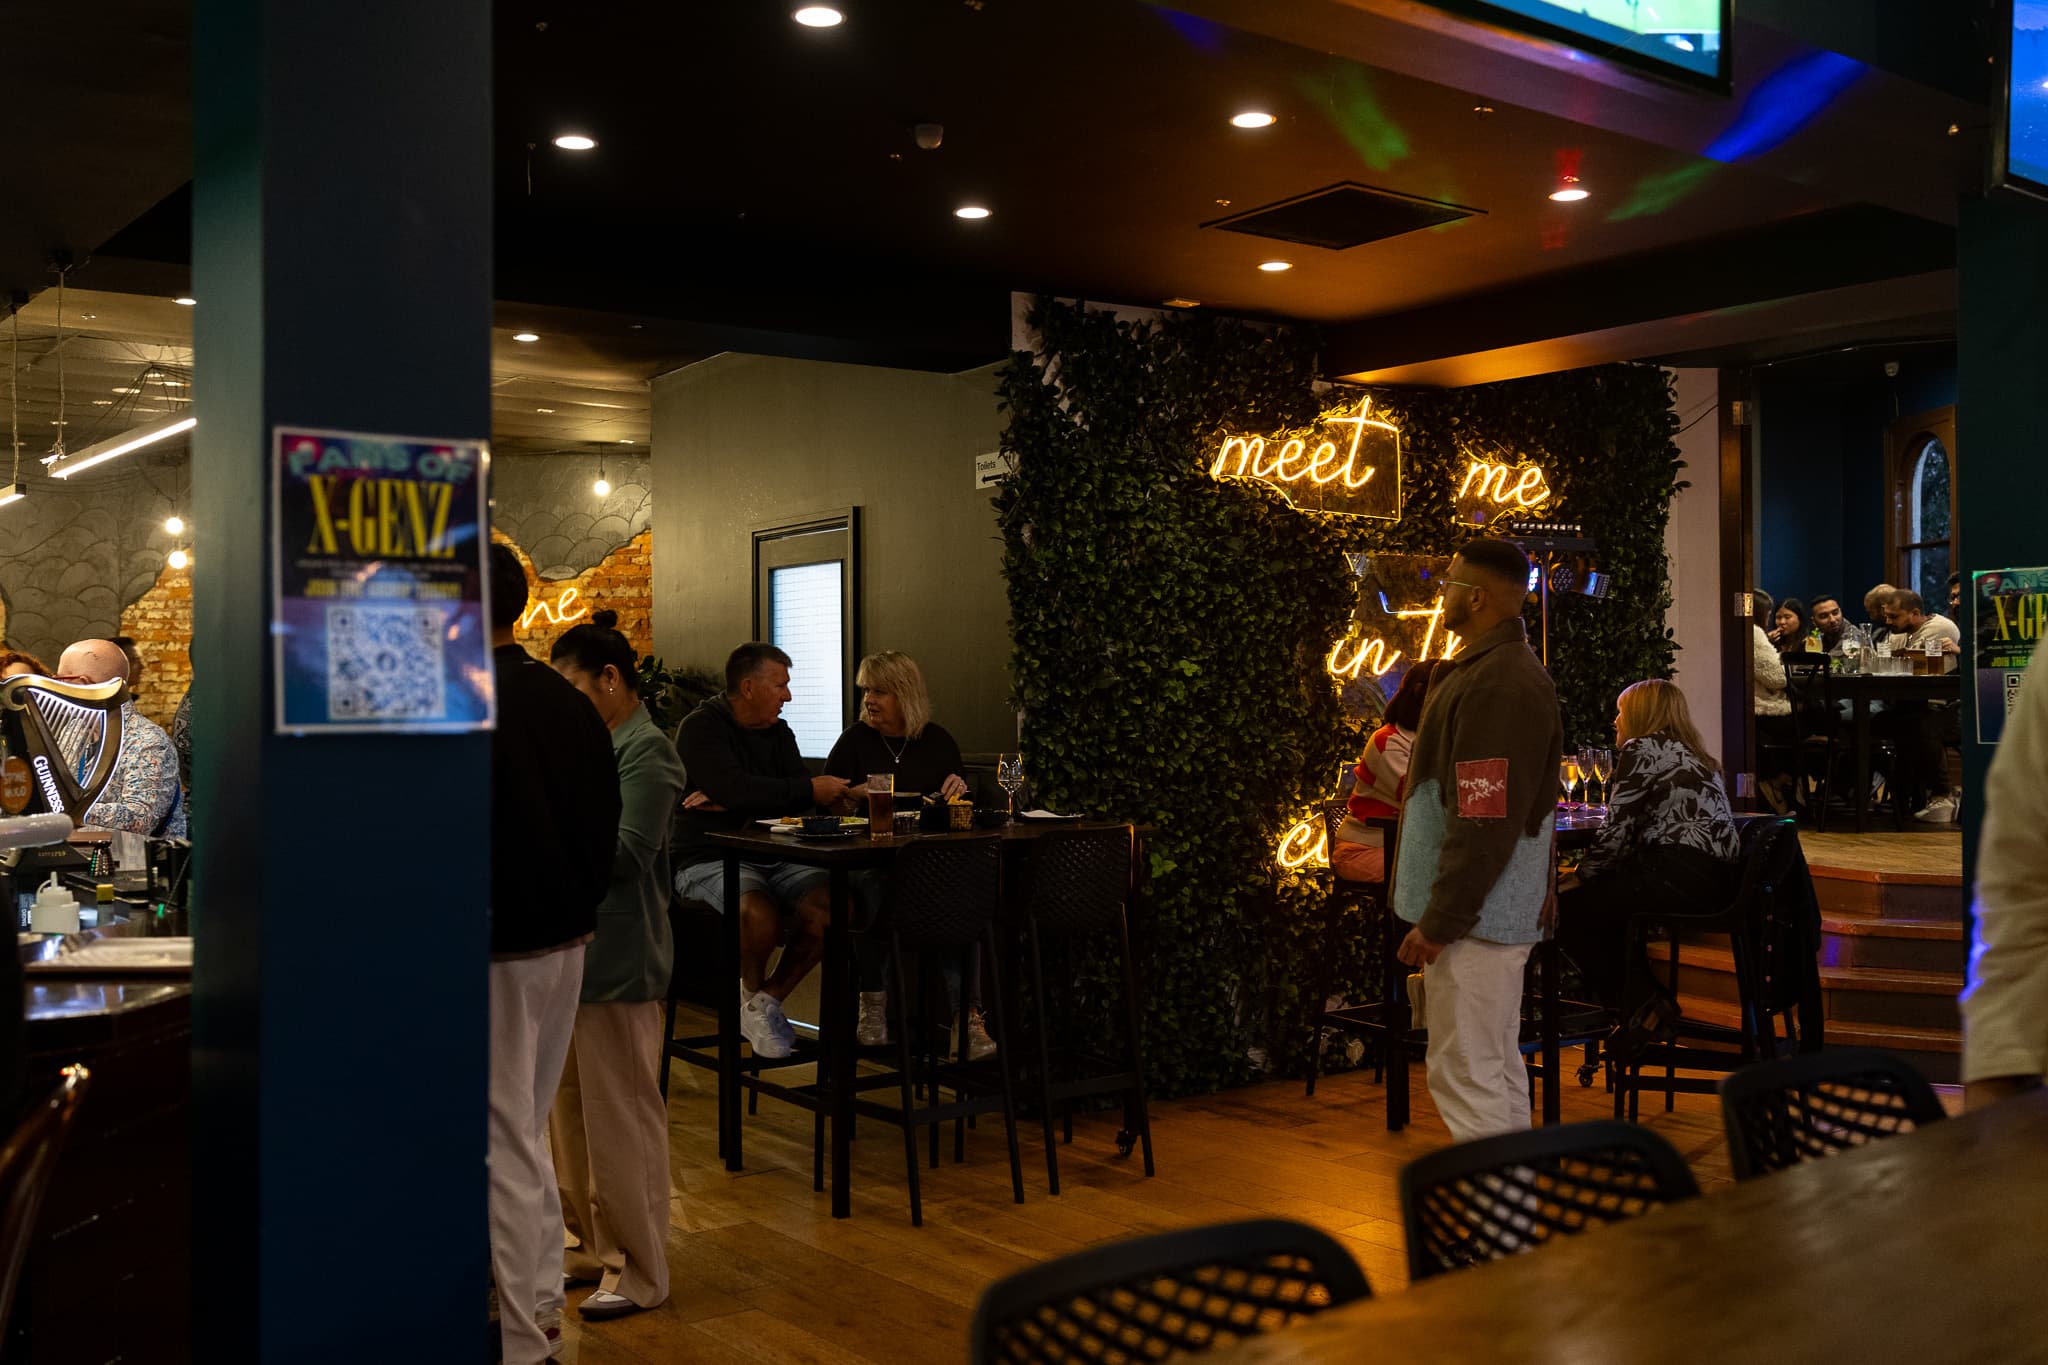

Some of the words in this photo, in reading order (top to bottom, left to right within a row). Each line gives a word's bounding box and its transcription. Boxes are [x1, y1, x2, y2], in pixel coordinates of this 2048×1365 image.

[416, 451, 475, 482] OF
[976, 460, 996, 471] Toilets
[1213, 394, 1398, 489] meet
[1458, 460, 1552, 507] me
[1327, 637, 1402, 678] in
[33, 755, 65, 814] GUINNESS
